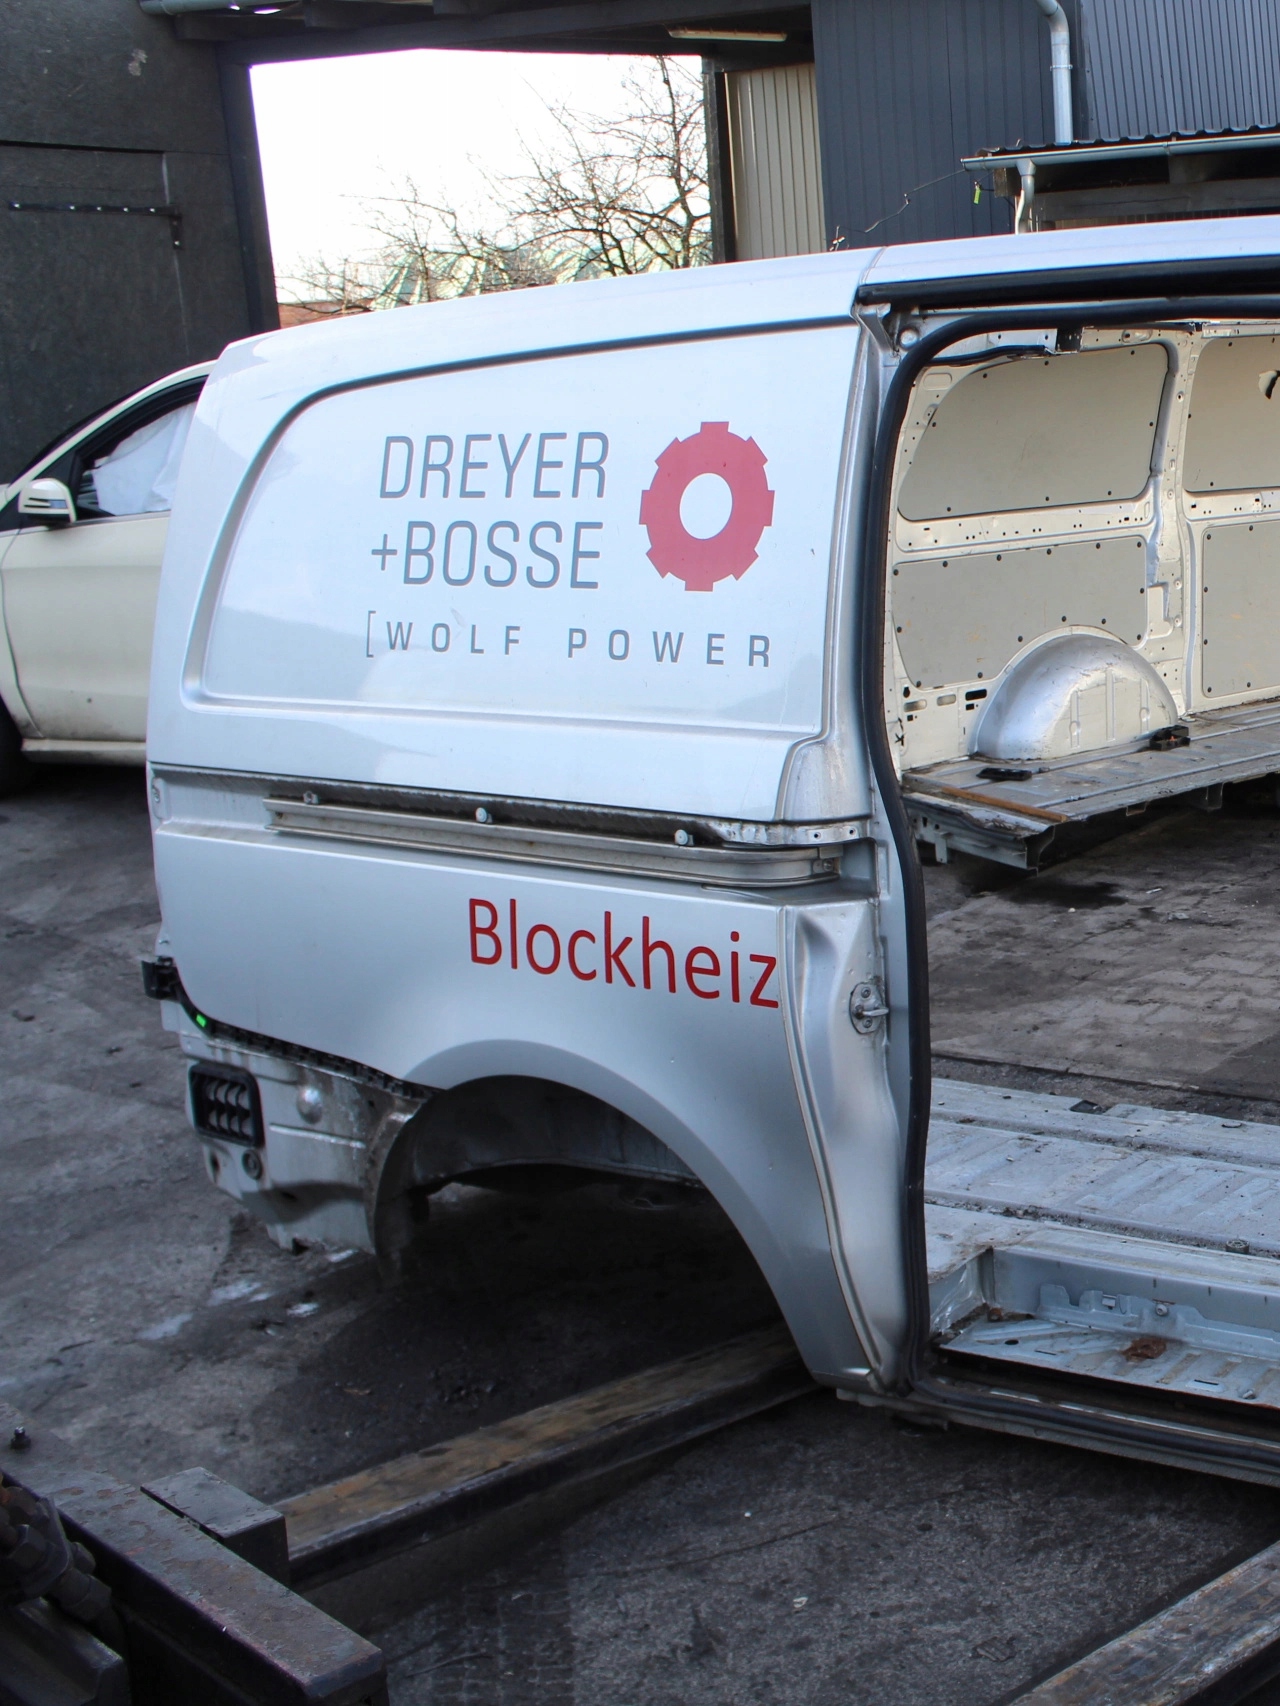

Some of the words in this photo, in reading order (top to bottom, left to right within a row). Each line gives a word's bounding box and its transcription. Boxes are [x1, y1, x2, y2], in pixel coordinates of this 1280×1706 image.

[379, 431, 610, 499] DREYER
[567, 626, 771, 668] POWER
[468, 897, 780, 1009] Blockheiz
